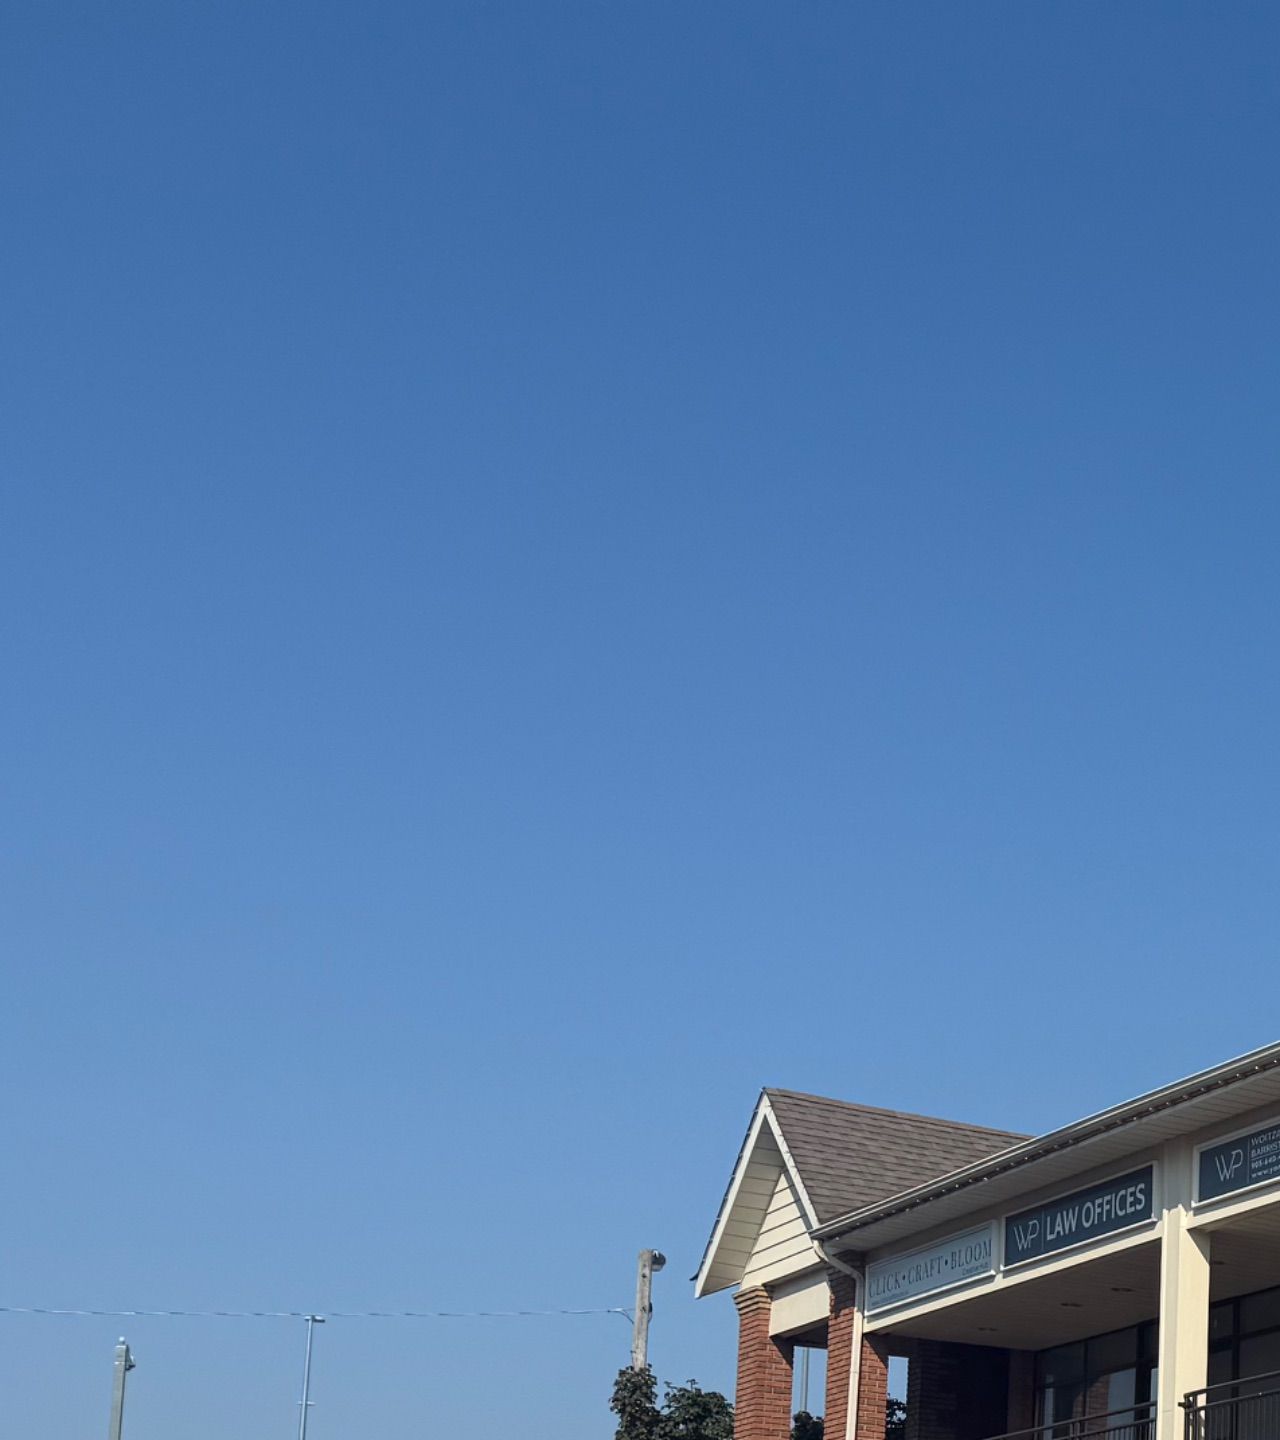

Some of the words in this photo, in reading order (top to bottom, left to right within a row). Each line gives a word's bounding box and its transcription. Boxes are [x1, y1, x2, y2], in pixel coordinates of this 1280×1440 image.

[1046, 1205, 1080, 1240] LAW
[1081, 1182, 1145, 1229] OFFICES
[869, 1270, 900, 1298] CLICK
[908, 1255, 943, 1285] CRAFT
[950, 1239, 992, 1270] BLOOM
